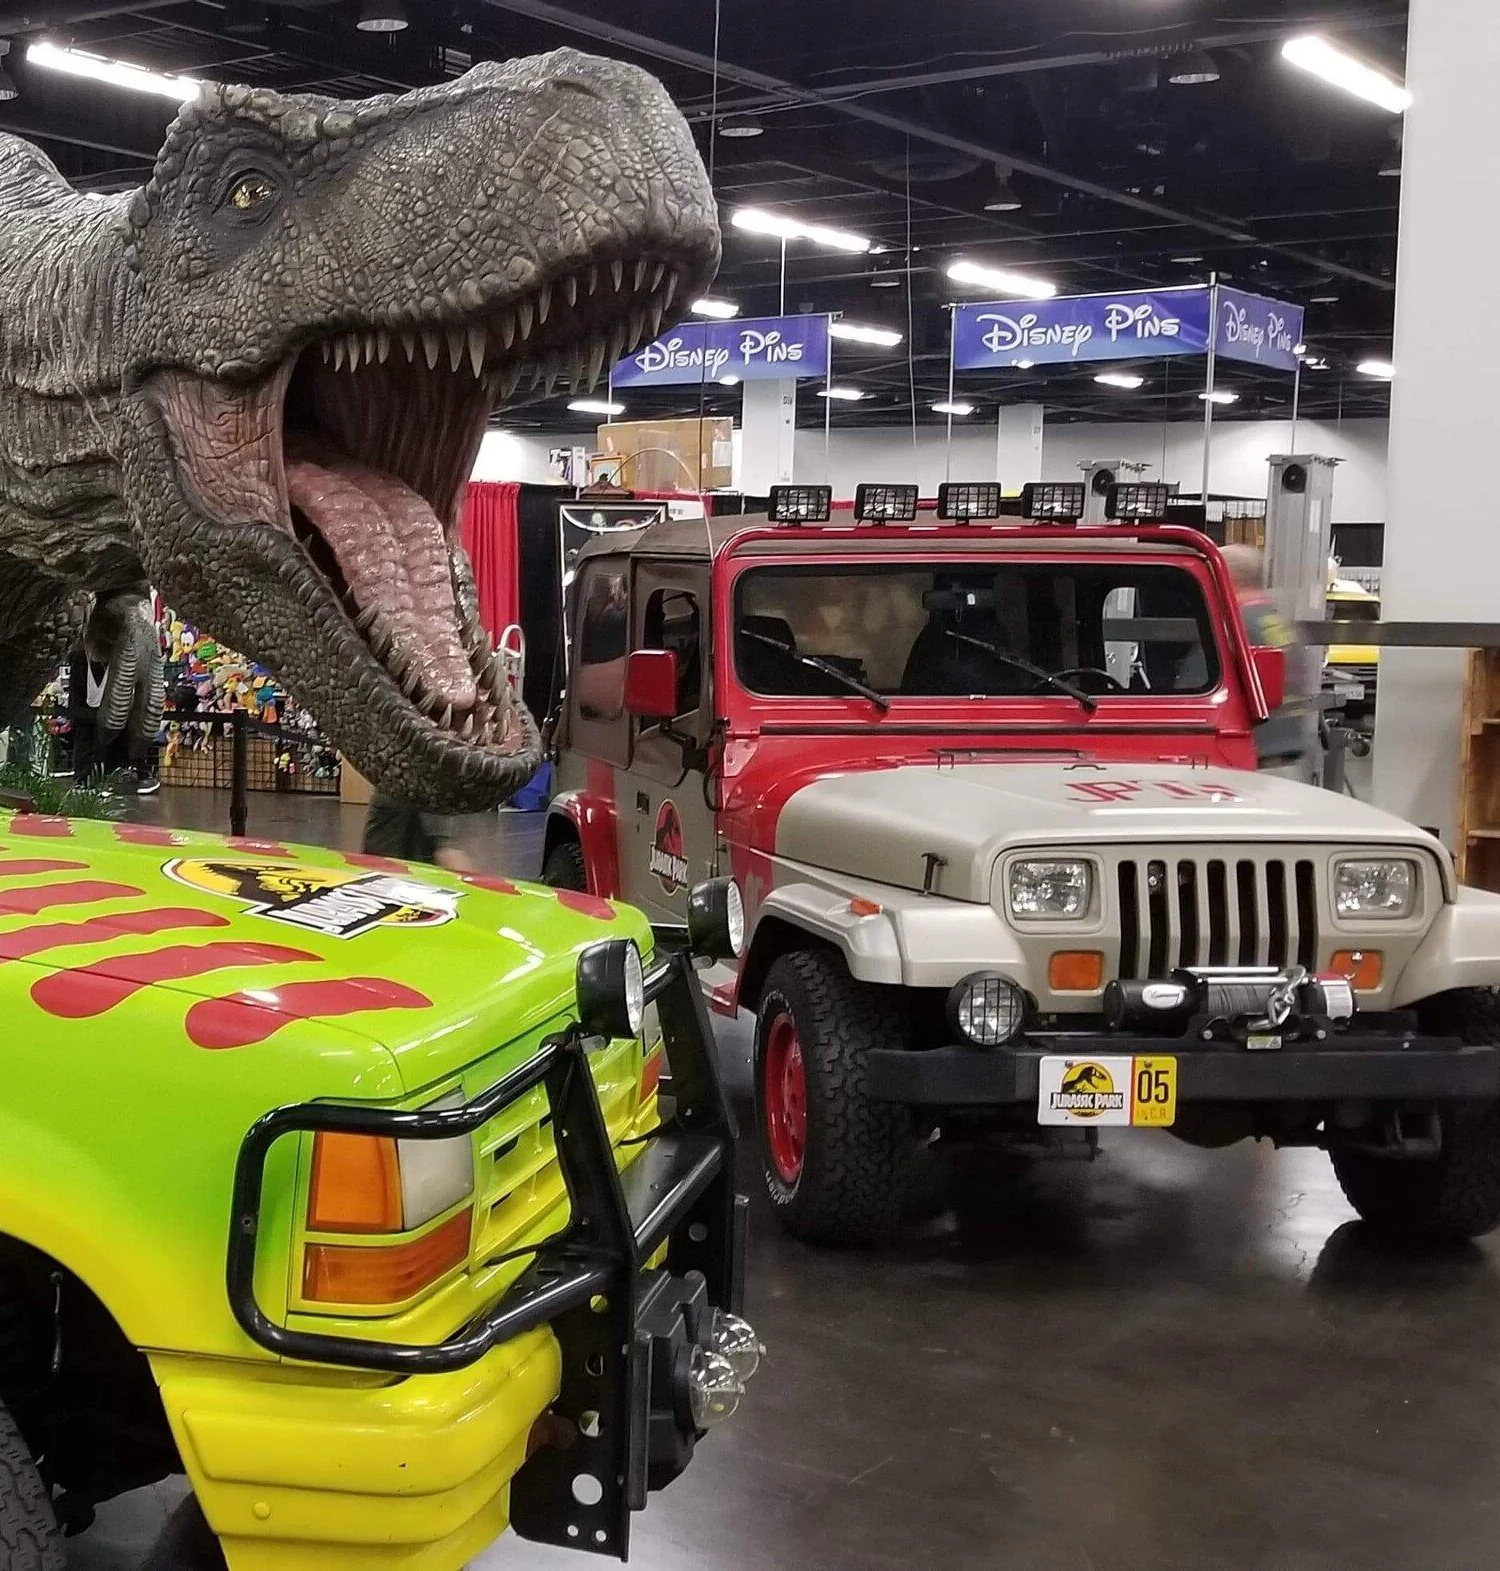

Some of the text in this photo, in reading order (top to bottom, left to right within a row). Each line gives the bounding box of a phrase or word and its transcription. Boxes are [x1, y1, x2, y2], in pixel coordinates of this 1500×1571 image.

[1136, 1070, 1170, 1103] 05
[1051, 1090, 1124, 1110] JURASSIC PARK
